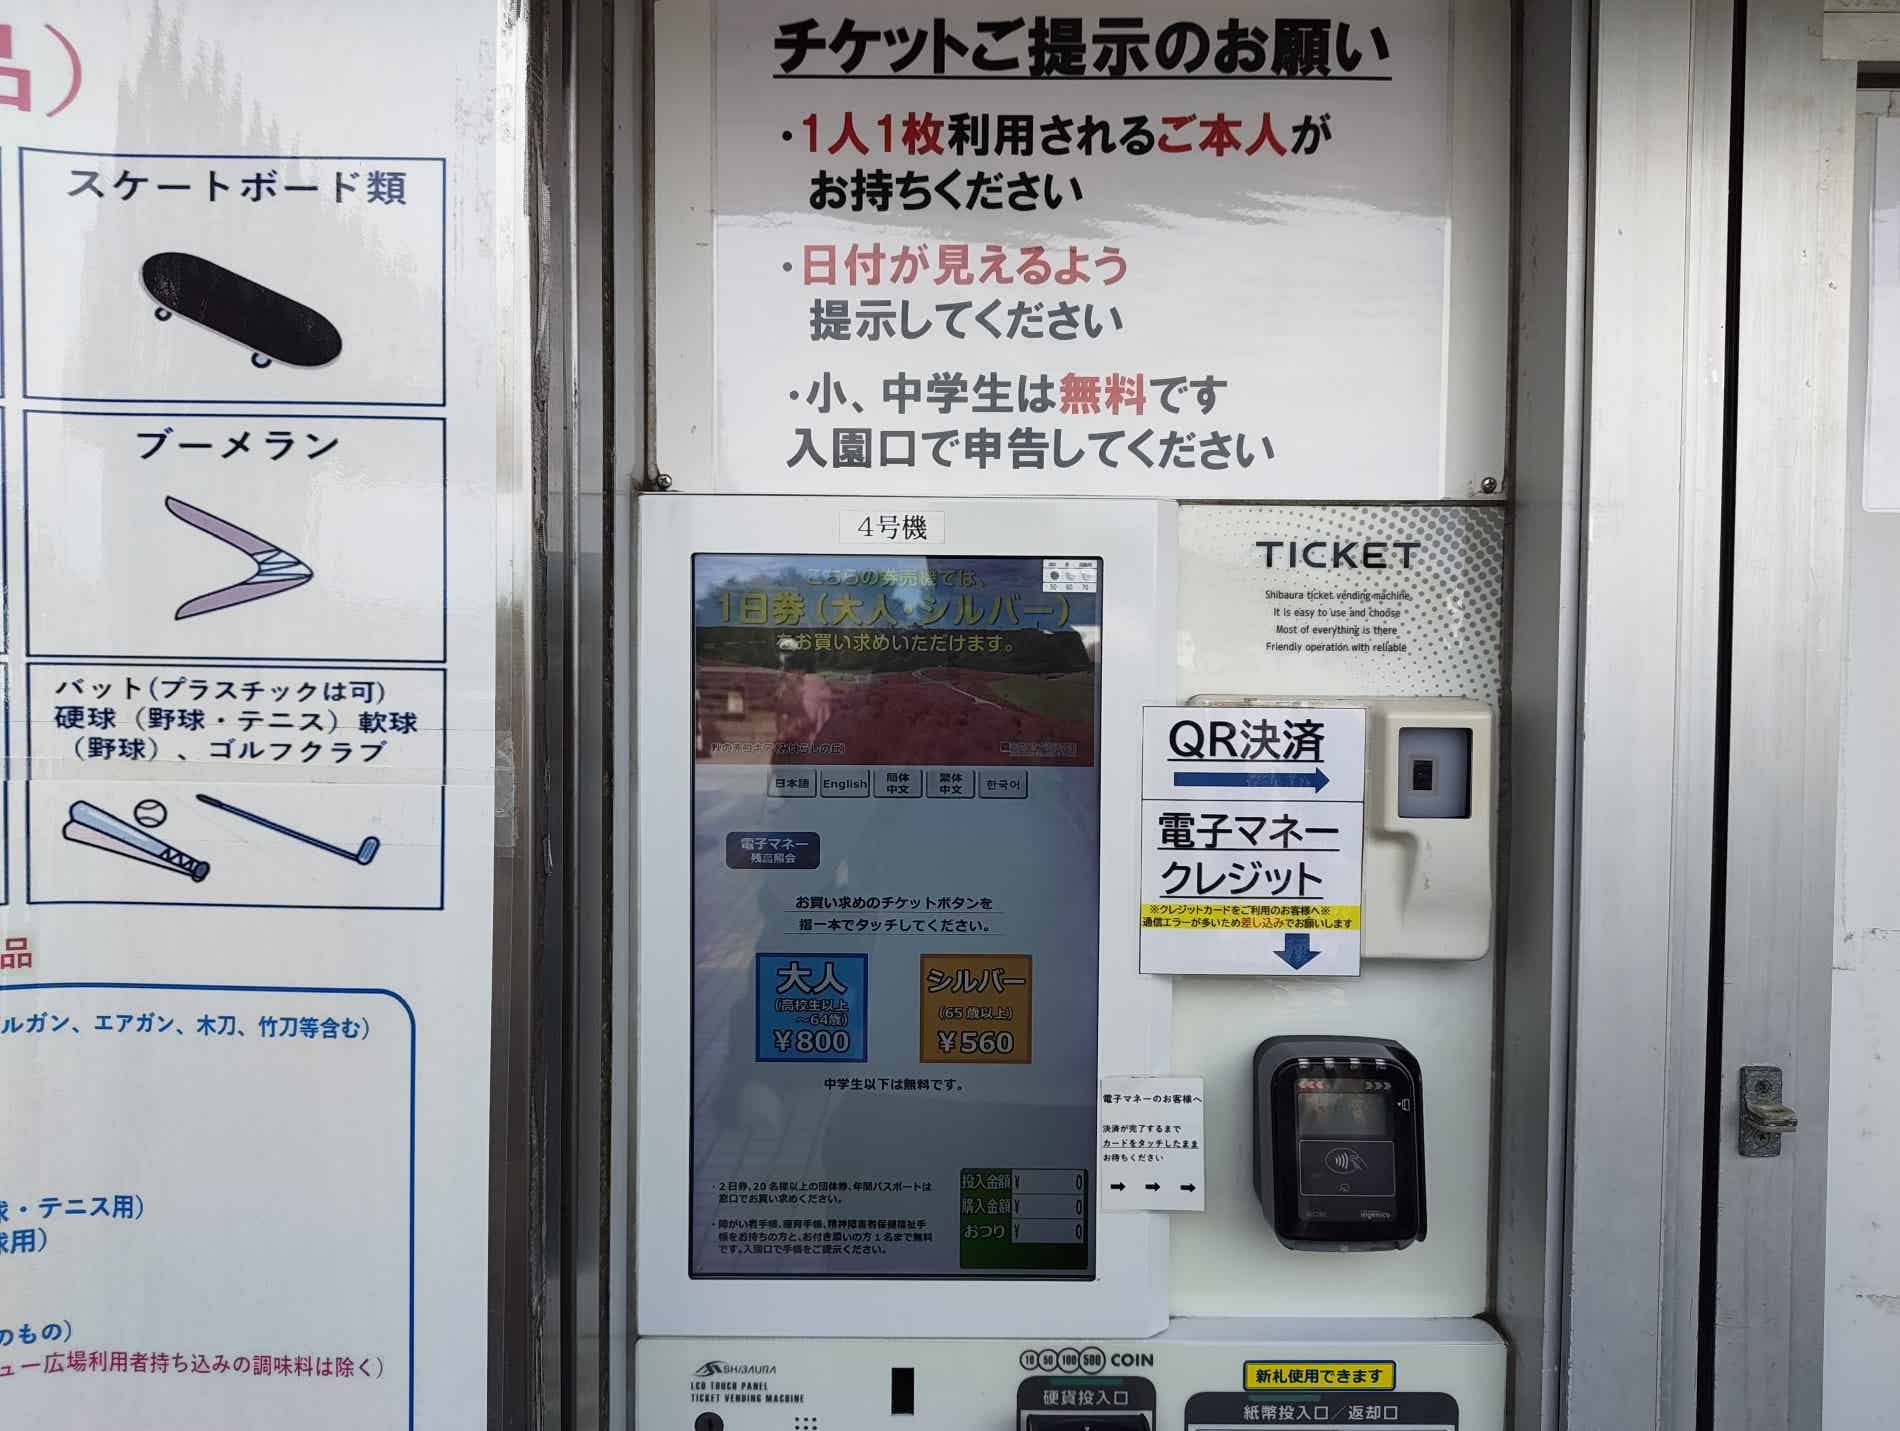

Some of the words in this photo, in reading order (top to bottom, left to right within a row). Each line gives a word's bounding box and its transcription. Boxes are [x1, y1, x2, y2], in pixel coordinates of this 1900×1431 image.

[773, 16, 1391, 77] チケットご提示のお願い
[66, 170, 407, 205] スケートボード類
[809, 169, 1084, 212] お持ちください
[809, 299, 1124, 341] 提示してください
[136, 426, 339, 461] ブーメラン
[786, 427, 1275, 471] 入園口で申告してください
[857, 513, 928, 542] 4号機
[1255, 541, 1422, 569] TICKET
[1265, 590, 1304, 600] Shibaura
[1307, 590, 1334, 600] ticket
[1336, 590, 1371, 601] vending
[1273, 608, 1281, 617] It
[1283, 608, 1291, 617] is
[1294, 609, 1314, 619] easy
[1318, 608, 1328, 617] to
[1330, 609, 1347, 618] use
[1350, 608, 1366, 617] and
[1369, 608, 1401, 618] choose
[1276, 625, 1298, 634] Most
[1300, 625, 1310, 634] of
[1312, 625, 1360, 637] everything
[1363, 626, 1371, 634] is
[1373, 625, 1398, 635] there
[776, 632, 1016, 654] をお買い求めいただけます。
[1266, 642, 1302, 653] Friendly
[1305, 642, 1350, 653] operation
[1351, 642, 1370, 652] with
[1372, 642, 1407, 652] reliable
[54, 676, 386, 704] バット(プラスチックは可)
[1168, 718, 1326, 761] QR決済
[74, 737, 388, 764] （野球）、ゴルフクラブ
[775, 778, 810, 790] 日本語
[822, 778, 868, 791] English
[886, 784, 909, 795] 中文
[939, 784, 963, 795] 中文
[986, 778, 1021, 791] 한국어
[1158, 811, 1340, 849] 電子マネー
[741, 837, 809, 851] 電子マネー
[1161, 860, 1324, 896] クレジット
[795, 896, 994, 911] お買い求めのチケットボタンを
[799, 917, 992, 933] 指一本でタッチしてください。
[1142, 916, 1353, 929] 通信エラーが多いため差し込みでお願いします
[0, 937, 32, 969] 品
[777, 962, 848, 995] 大人
[927, 968, 1026, 993] シルバー
[1, 1012, 370, 1040] ルガン、エアガン、木刀、竹刀等含む)
[824, 1078, 966, 1091] 中学生以下は無料です。
[1103, 1094, 1202, 1104] 電子マネーのお客様へ
[1103, 1124, 1181, 1133] 決済が完了するまで
[1103, 1139, 1198, 1148] カードをタッチしたまま
[962, 1174, 1011, 1190] 投入金額
[1075, 1174, 1083, 1190] 0
[962, 1198, 1011, 1215] 購入金額
[1075, 1199, 1083, 1215] 0
[964, 1224, 1005, 1239] おつり
[1075, 1223, 1083, 1239] 0
[1025, 1354, 1035, 1365] 10
[1043, 1354, 1053, 1365] 50
[1062, 1354, 1077, 1365] 100
[1083, 1354, 1101, 1366] 500
[1111, 1354, 1154, 1367] COIN
[1255, 1369, 1383, 1384] 新札使用できます
[711, 1381, 738, 1391] TOUCH
[741, 1381, 769, 1391] PANEL
[691, 1393, 720, 1403] TICKET
[724, 1393, 762, 1403] VENDING
[765, 1393, 805, 1403] MACHINE
[1043, 1388, 1130, 1406] 硬貨投入口
[1242, 1404, 1400, 1421] 紙幣投入口／返却口
